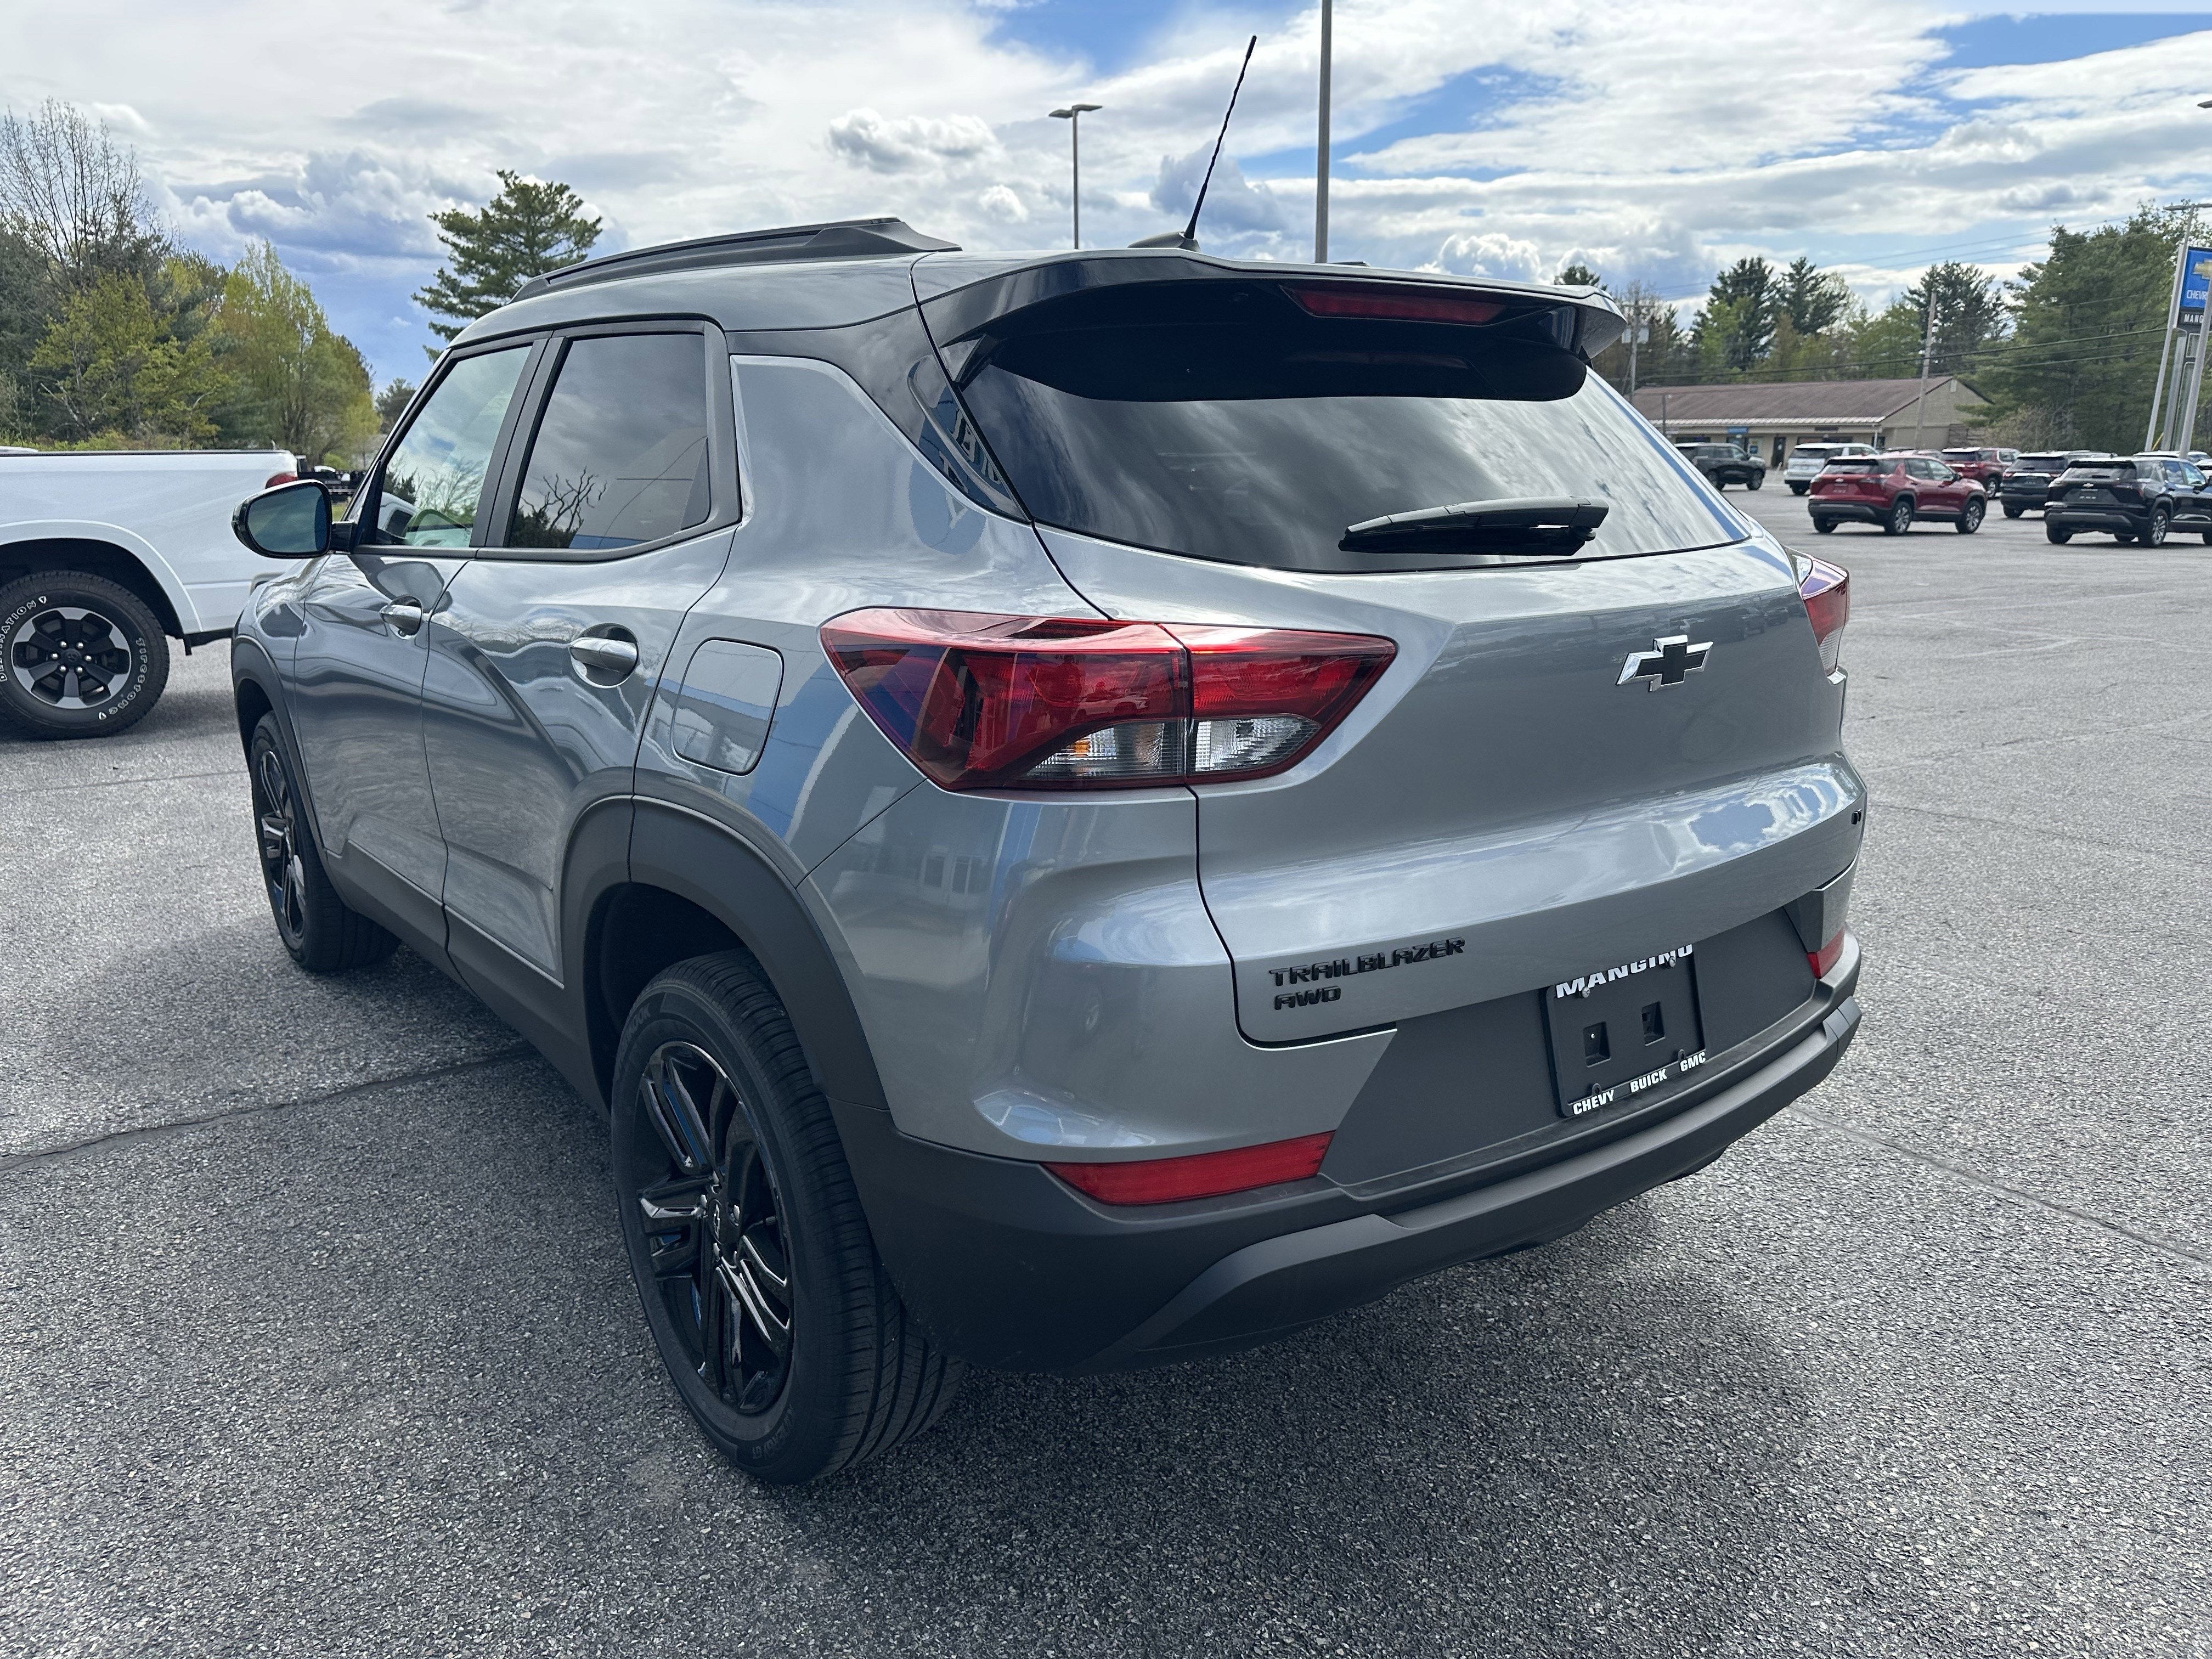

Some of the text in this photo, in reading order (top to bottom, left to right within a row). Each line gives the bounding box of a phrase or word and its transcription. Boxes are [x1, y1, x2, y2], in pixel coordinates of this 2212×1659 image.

[1268, 936, 1465, 986] TRAILBLAZER
[1556, 944, 1693, 998] MANGINO
[1274, 985, 1341, 1011] AWD
[1573, 1052, 1706, 1115] CHEVY BUICK GMC
